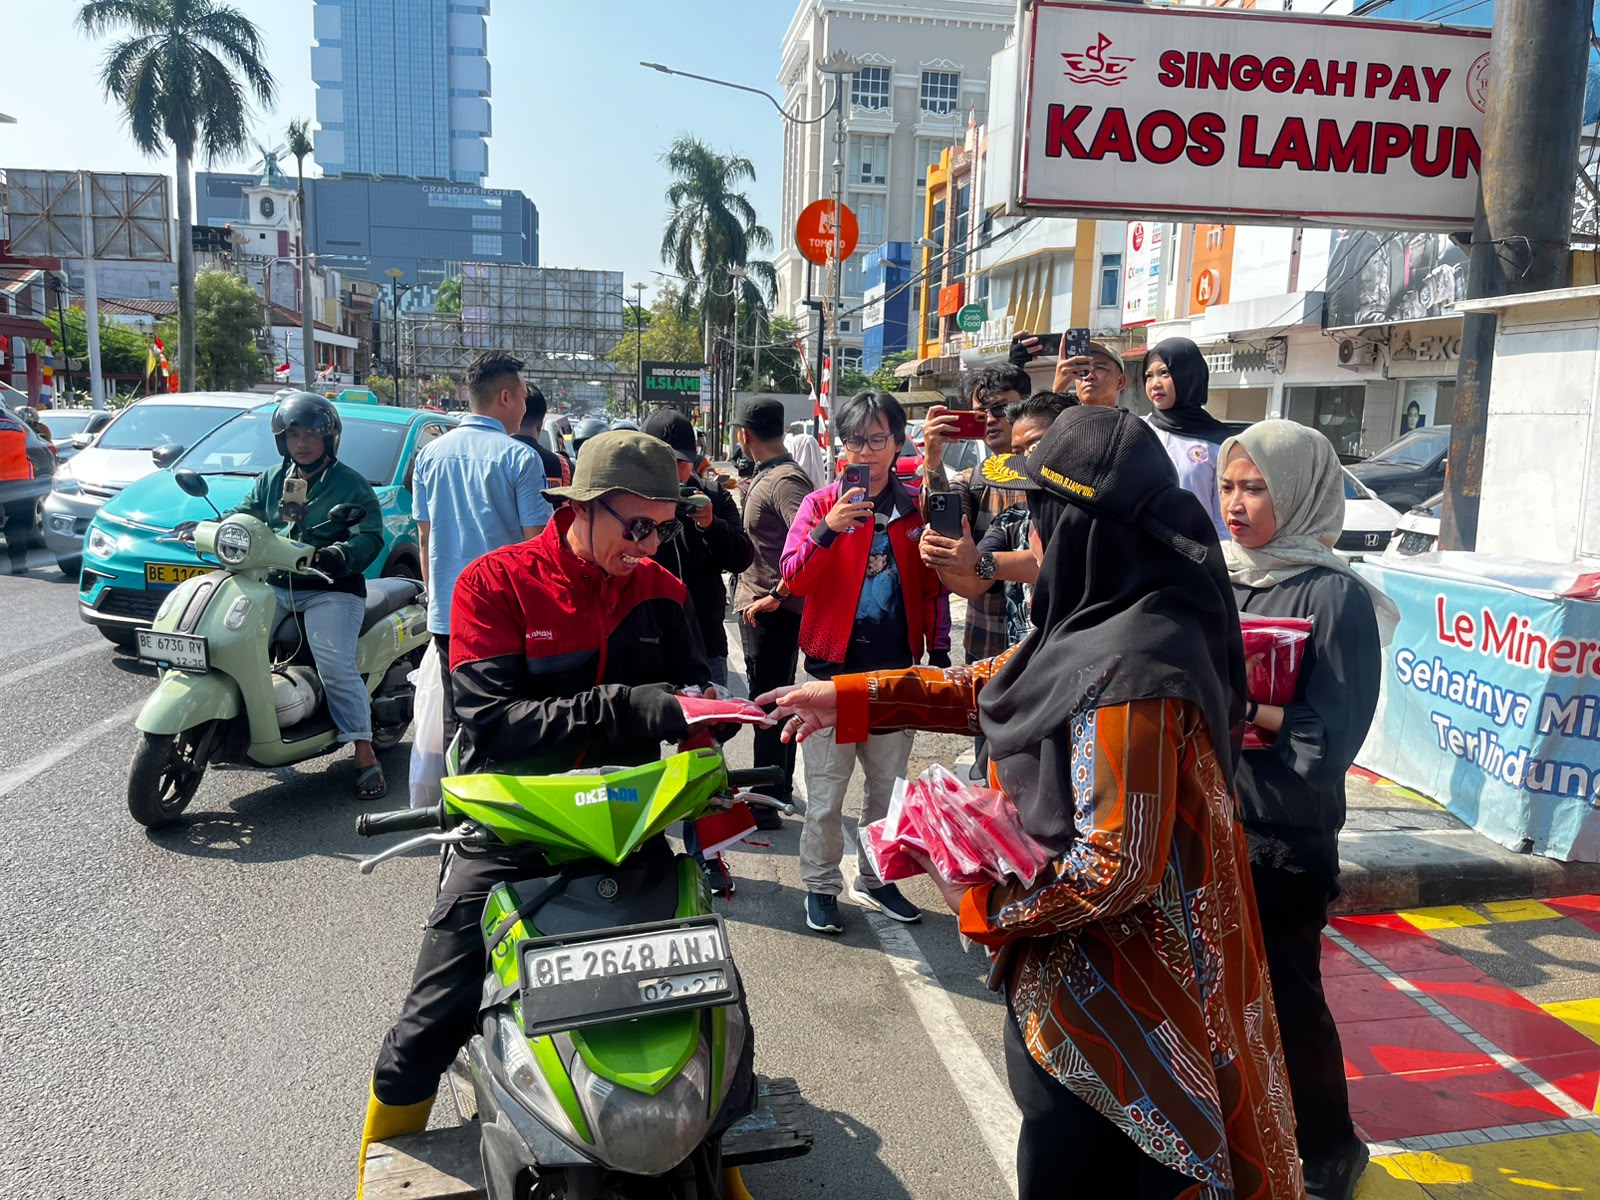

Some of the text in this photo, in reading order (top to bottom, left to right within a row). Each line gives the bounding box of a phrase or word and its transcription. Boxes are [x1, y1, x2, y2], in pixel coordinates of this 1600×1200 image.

[1158, 50, 1357, 97] SINGGAH
[1365, 63, 1451, 103] PAY
[1045, 103, 1226, 167] KAOS
[421, 184, 515, 196] GRAND MERCURE
[964, 313, 981, 321] Grab
[651, 368, 675, 376] BEBEK
[149, 566, 166, 581] BE
[1435, 593, 1476, 649] Le
[140, 635, 152, 648] BE
[189, 641, 202, 654] RY
[1395, 648, 1600, 739] Sehatnya Mi
[535, 954, 575, 987] BE
[583, 943, 655, 980] 2648
